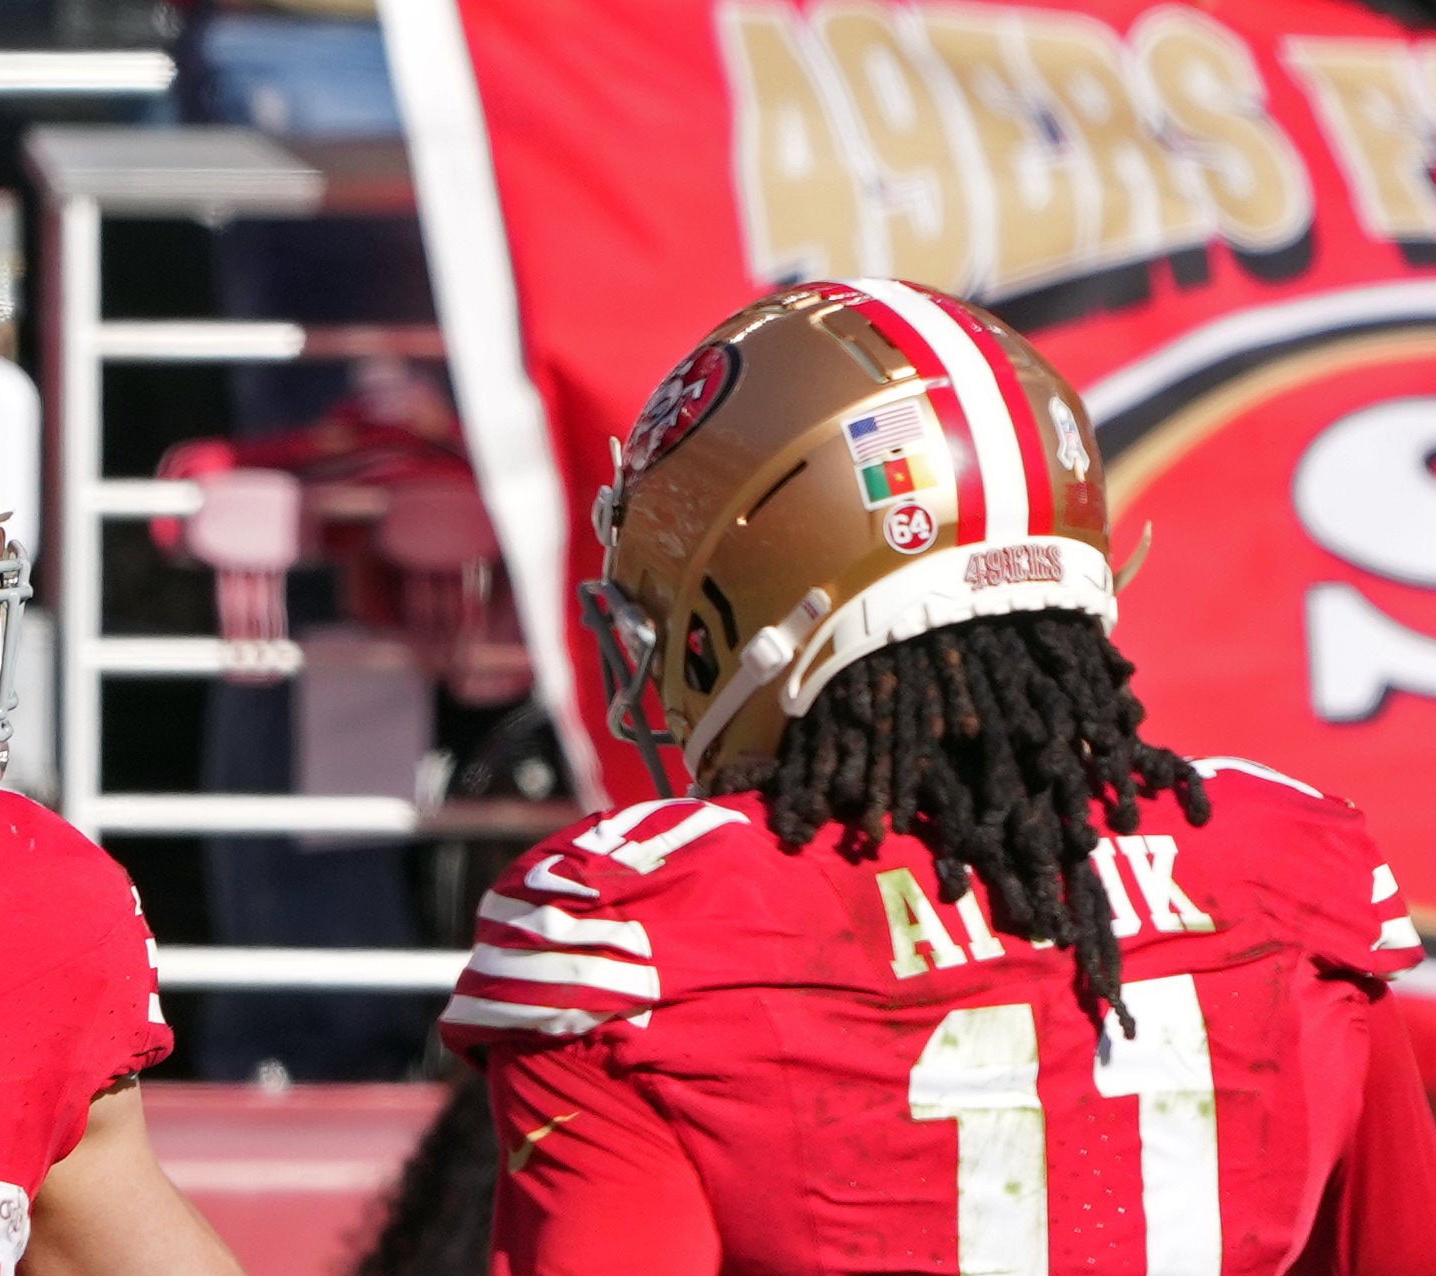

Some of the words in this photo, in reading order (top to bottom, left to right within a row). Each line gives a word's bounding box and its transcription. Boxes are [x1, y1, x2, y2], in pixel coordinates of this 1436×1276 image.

[722, 4, 1314, 302] 49ERS
[888, 509, 932, 545] 64
[964, 544, 1064, 591] 49ERS
[874, 834, 1217, 980] AIK
